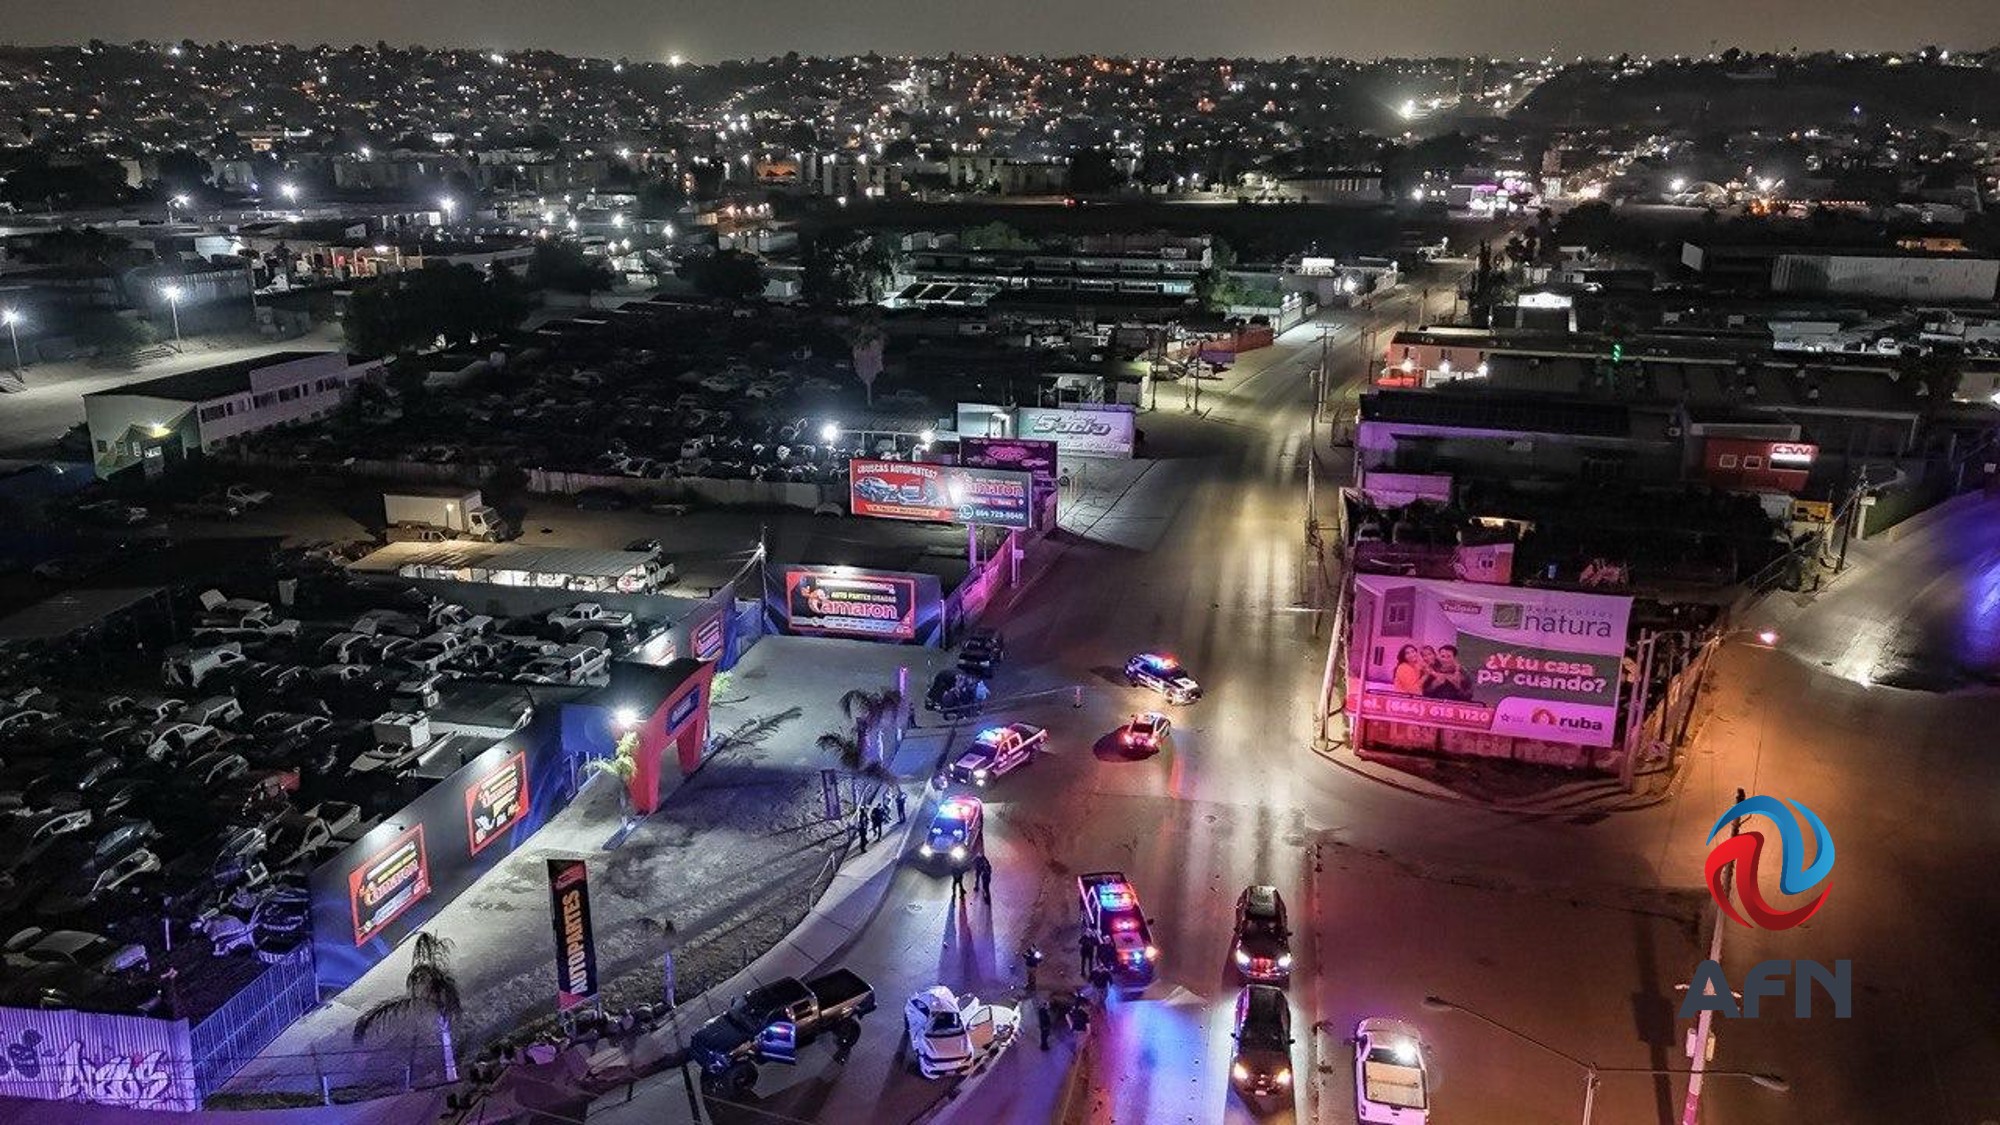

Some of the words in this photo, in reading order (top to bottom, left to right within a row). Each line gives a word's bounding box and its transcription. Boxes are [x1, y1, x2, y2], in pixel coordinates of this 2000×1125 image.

[1524, 615, 1612, 638] natura
[1486, 652, 1512, 670] ¿Y
[1515, 655, 1539, 671] tu
[1543, 660, 1593, 677] casa
[1513, 673, 1607, 694] cuando?
[1458, 708, 1491, 722] 1120
[1559, 716, 1603, 731] ruba
[561, 889, 589, 996] AUTOPARTES
